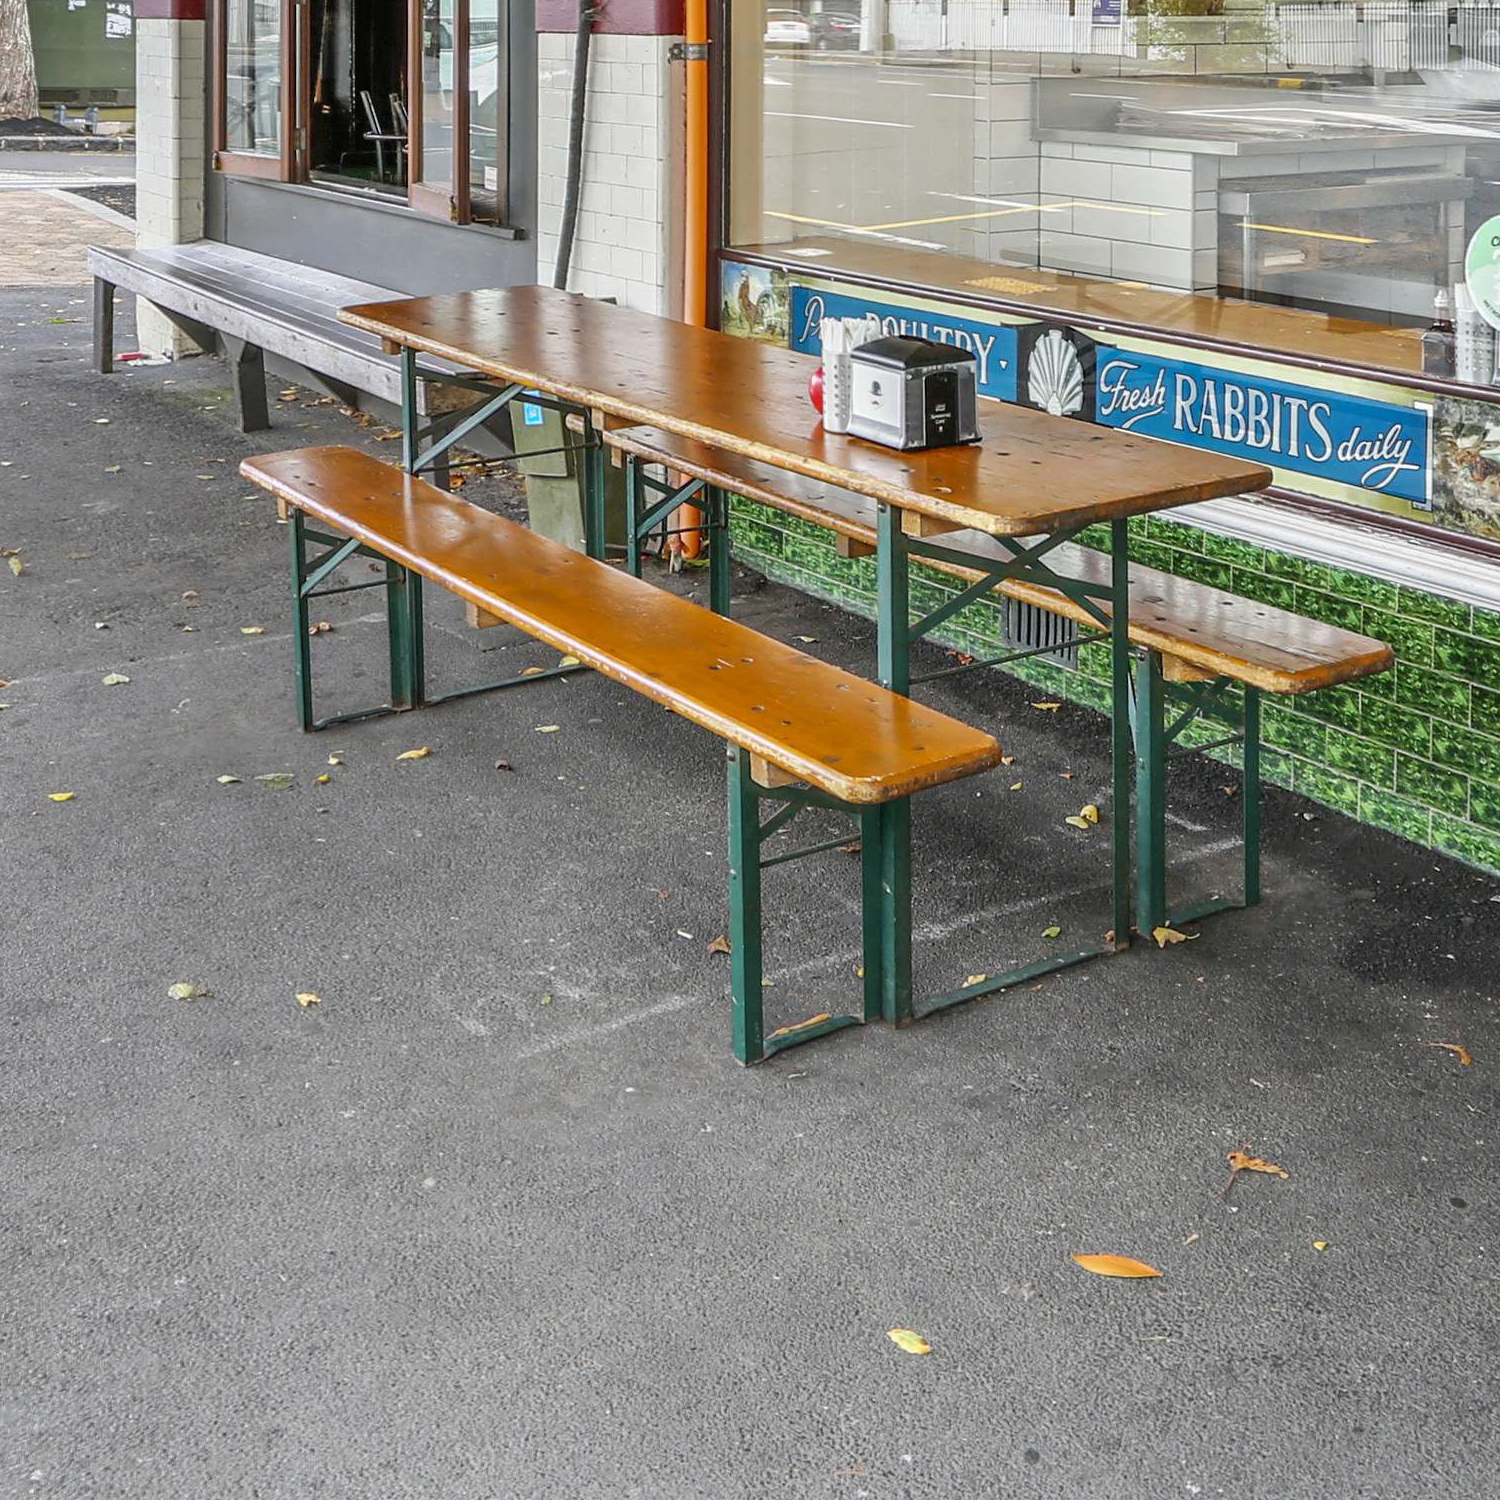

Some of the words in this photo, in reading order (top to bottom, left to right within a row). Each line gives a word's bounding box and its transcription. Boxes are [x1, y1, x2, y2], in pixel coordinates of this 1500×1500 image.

[1100, 360, 1167, 429] Fresh
[1173, 373, 1332, 463] RABBITS
[1337, 424, 1420, 489] daily
